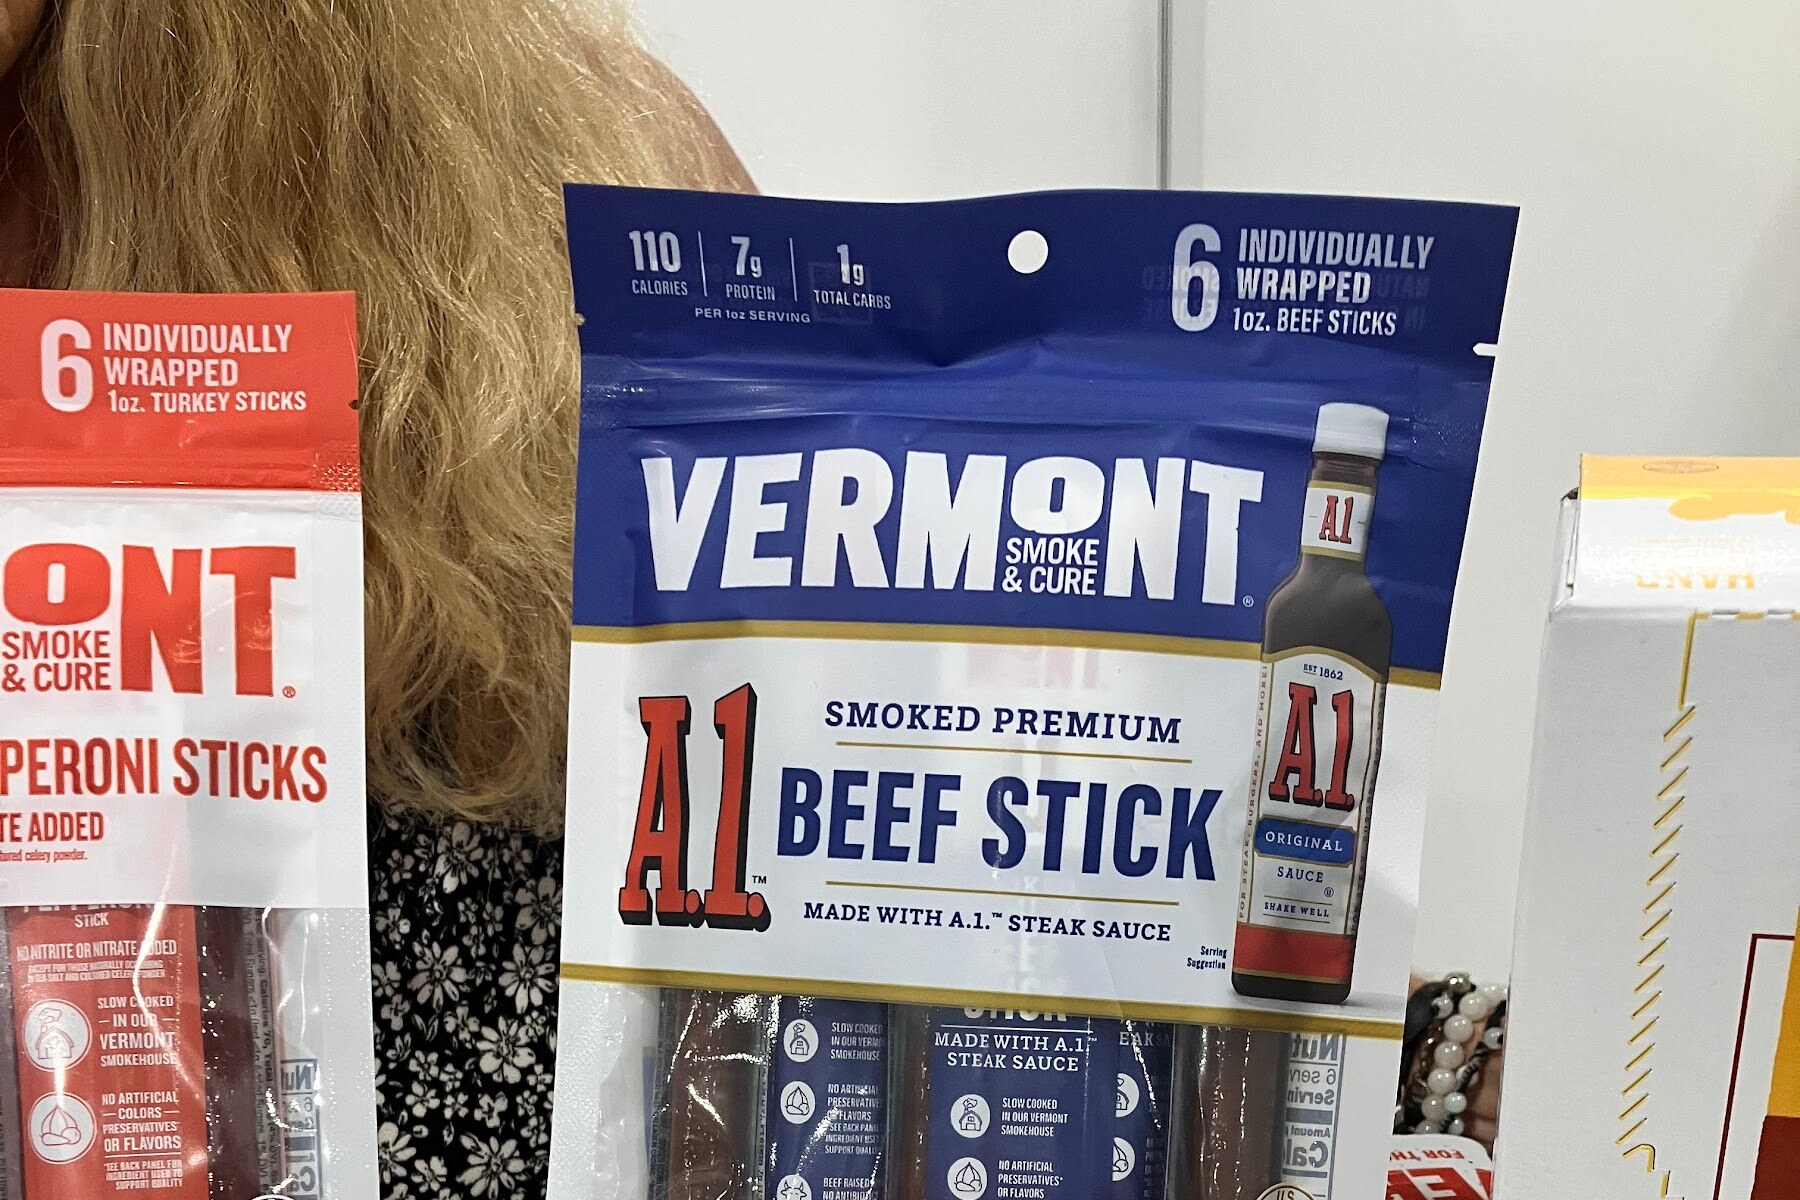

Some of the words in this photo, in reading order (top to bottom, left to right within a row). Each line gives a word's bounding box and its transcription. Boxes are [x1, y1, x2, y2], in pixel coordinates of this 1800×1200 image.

[629, 230, 680, 273] 110
[731, 235, 762, 279] 7g
[1239, 228, 1435, 270] INDIVIDUALLY
[837, 244, 864, 287] 1g
[1171, 223, 1221, 331] 6
[1237, 267, 1371, 304] WRAPPED
[631, 279, 688, 297] CALORIES
[725, 282, 776, 301] PROTEIN
[813, 289, 850, 308] TOTAL
[853, 292, 892, 310] CARBS
[694, 307, 721, 320] PER
[725, 308, 745, 320] 1oz
[749, 309, 810, 323] SERVING
[1233, 308, 1271, 332] 1oz.
[1277, 308, 1323, 333] BEEF
[1328, 309, 1397, 337] STICKS
[103, 323, 292, 354] INDIVIDUALLY
[40, 319, 94, 413] 6
[104, 357, 239, 387] WRAPPED
[108, 389, 146, 413] 1oz.
[150, 391, 228, 413] TURKEY
[234, 391, 307, 411] STICKS
[641, 448, 1264, 606] VERMONT
[1005, 537, 1099, 568] SMOKE
[1002, 566, 1023, 593] &
[1029, 566, 1097, 596] CURE
[1, 630, 111, 660] SMOKE
[2, 663, 26, 691] &
[33, 663, 111, 691] CURE
[1319, 666, 1343, 681] 1862
[825, 701, 980, 732] SMOKED
[992, 707, 1181, 744] PREMIUM
[1255, 718, 1263, 748] AND
[173, 738, 328, 803] STICKS
[619, 682, 771, 933] A.1.
[27, 811, 104, 842] ADDED
[777, 766, 961, 864] BEEF
[981, 775, 1224, 882] STICK
[1265, 831, 1343, 852] ORIGINAL
[1277, 866, 1324, 883] SAUCE
[1264, 901, 1296, 914] SHAKE
[1300, 905, 1330, 917] WELL
[75, 912, 109, 928] STICK
[803, 902, 870, 922] MADE
[876, 906, 943, 927] WITH
[1008, 914, 1086, 937] STEAK
[1092, 919, 1171, 942] SAUCE
[1187, 957, 1226, 970] Suggestion
[98, 997, 126, 1009] SLOW
[113, 1014, 127, 1027] IN
[100, 1032, 176, 1050] VERMONT
[934, 1031, 989, 1049] MADE
[994, 1035, 1049, 1050] WITH
[101, 1053, 178, 1067] SMOKEHOUSE
[947, 1052, 1006, 1069] STEAK
[1012, 1055, 1079, 1072] SAUCE
[102, 1093, 115, 1106] NO
[118, 1091, 179, 1104] ARTIFICIAL
[1002, 1097, 1025, 1109] SLOW
[1026, 1098, 1058, 1110] COOKED
[118, 1107, 162, 1120] COLORS
[1012, 1112, 1029, 1123] OUR
[1030, 1113, 1068, 1124] VERMONT
[1001, 1125, 1055, 1137] SMOKEHOUSE
[104, 1138, 120, 1152] OR
[124, 1136, 182, 1151] FLAVORS
[1011, 1161, 1054, 1173] ARTIFICIAL
[1010, 1187, 1045, 1199] FLAVORS
